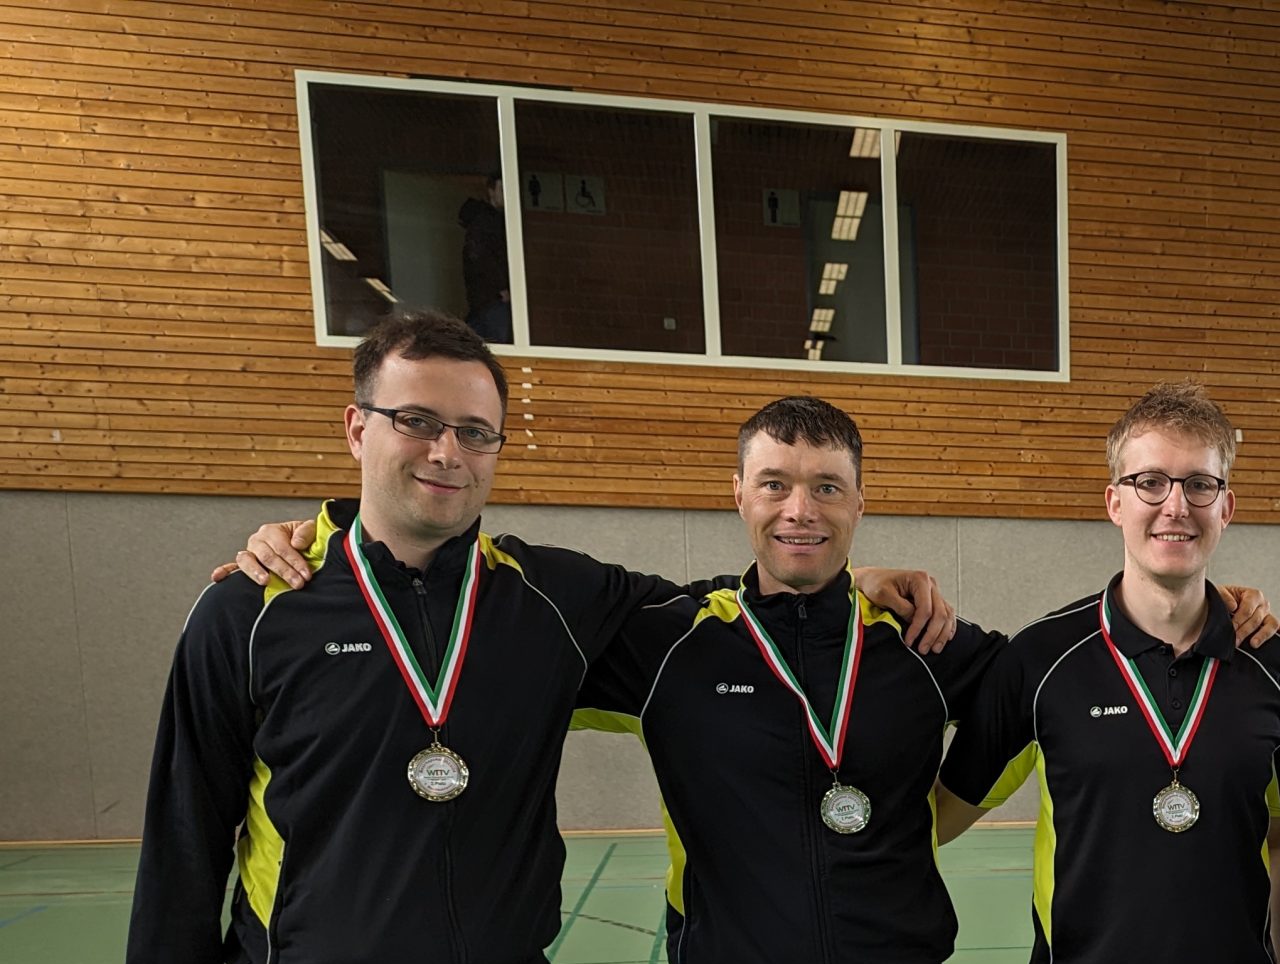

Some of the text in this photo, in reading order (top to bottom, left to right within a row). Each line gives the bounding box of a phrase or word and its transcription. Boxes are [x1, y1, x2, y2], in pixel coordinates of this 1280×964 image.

[341, 643, 372, 653] JAKO
[729, 685, 755, 694] JAKO
[1103, 705, 1128, 716] JAKO
